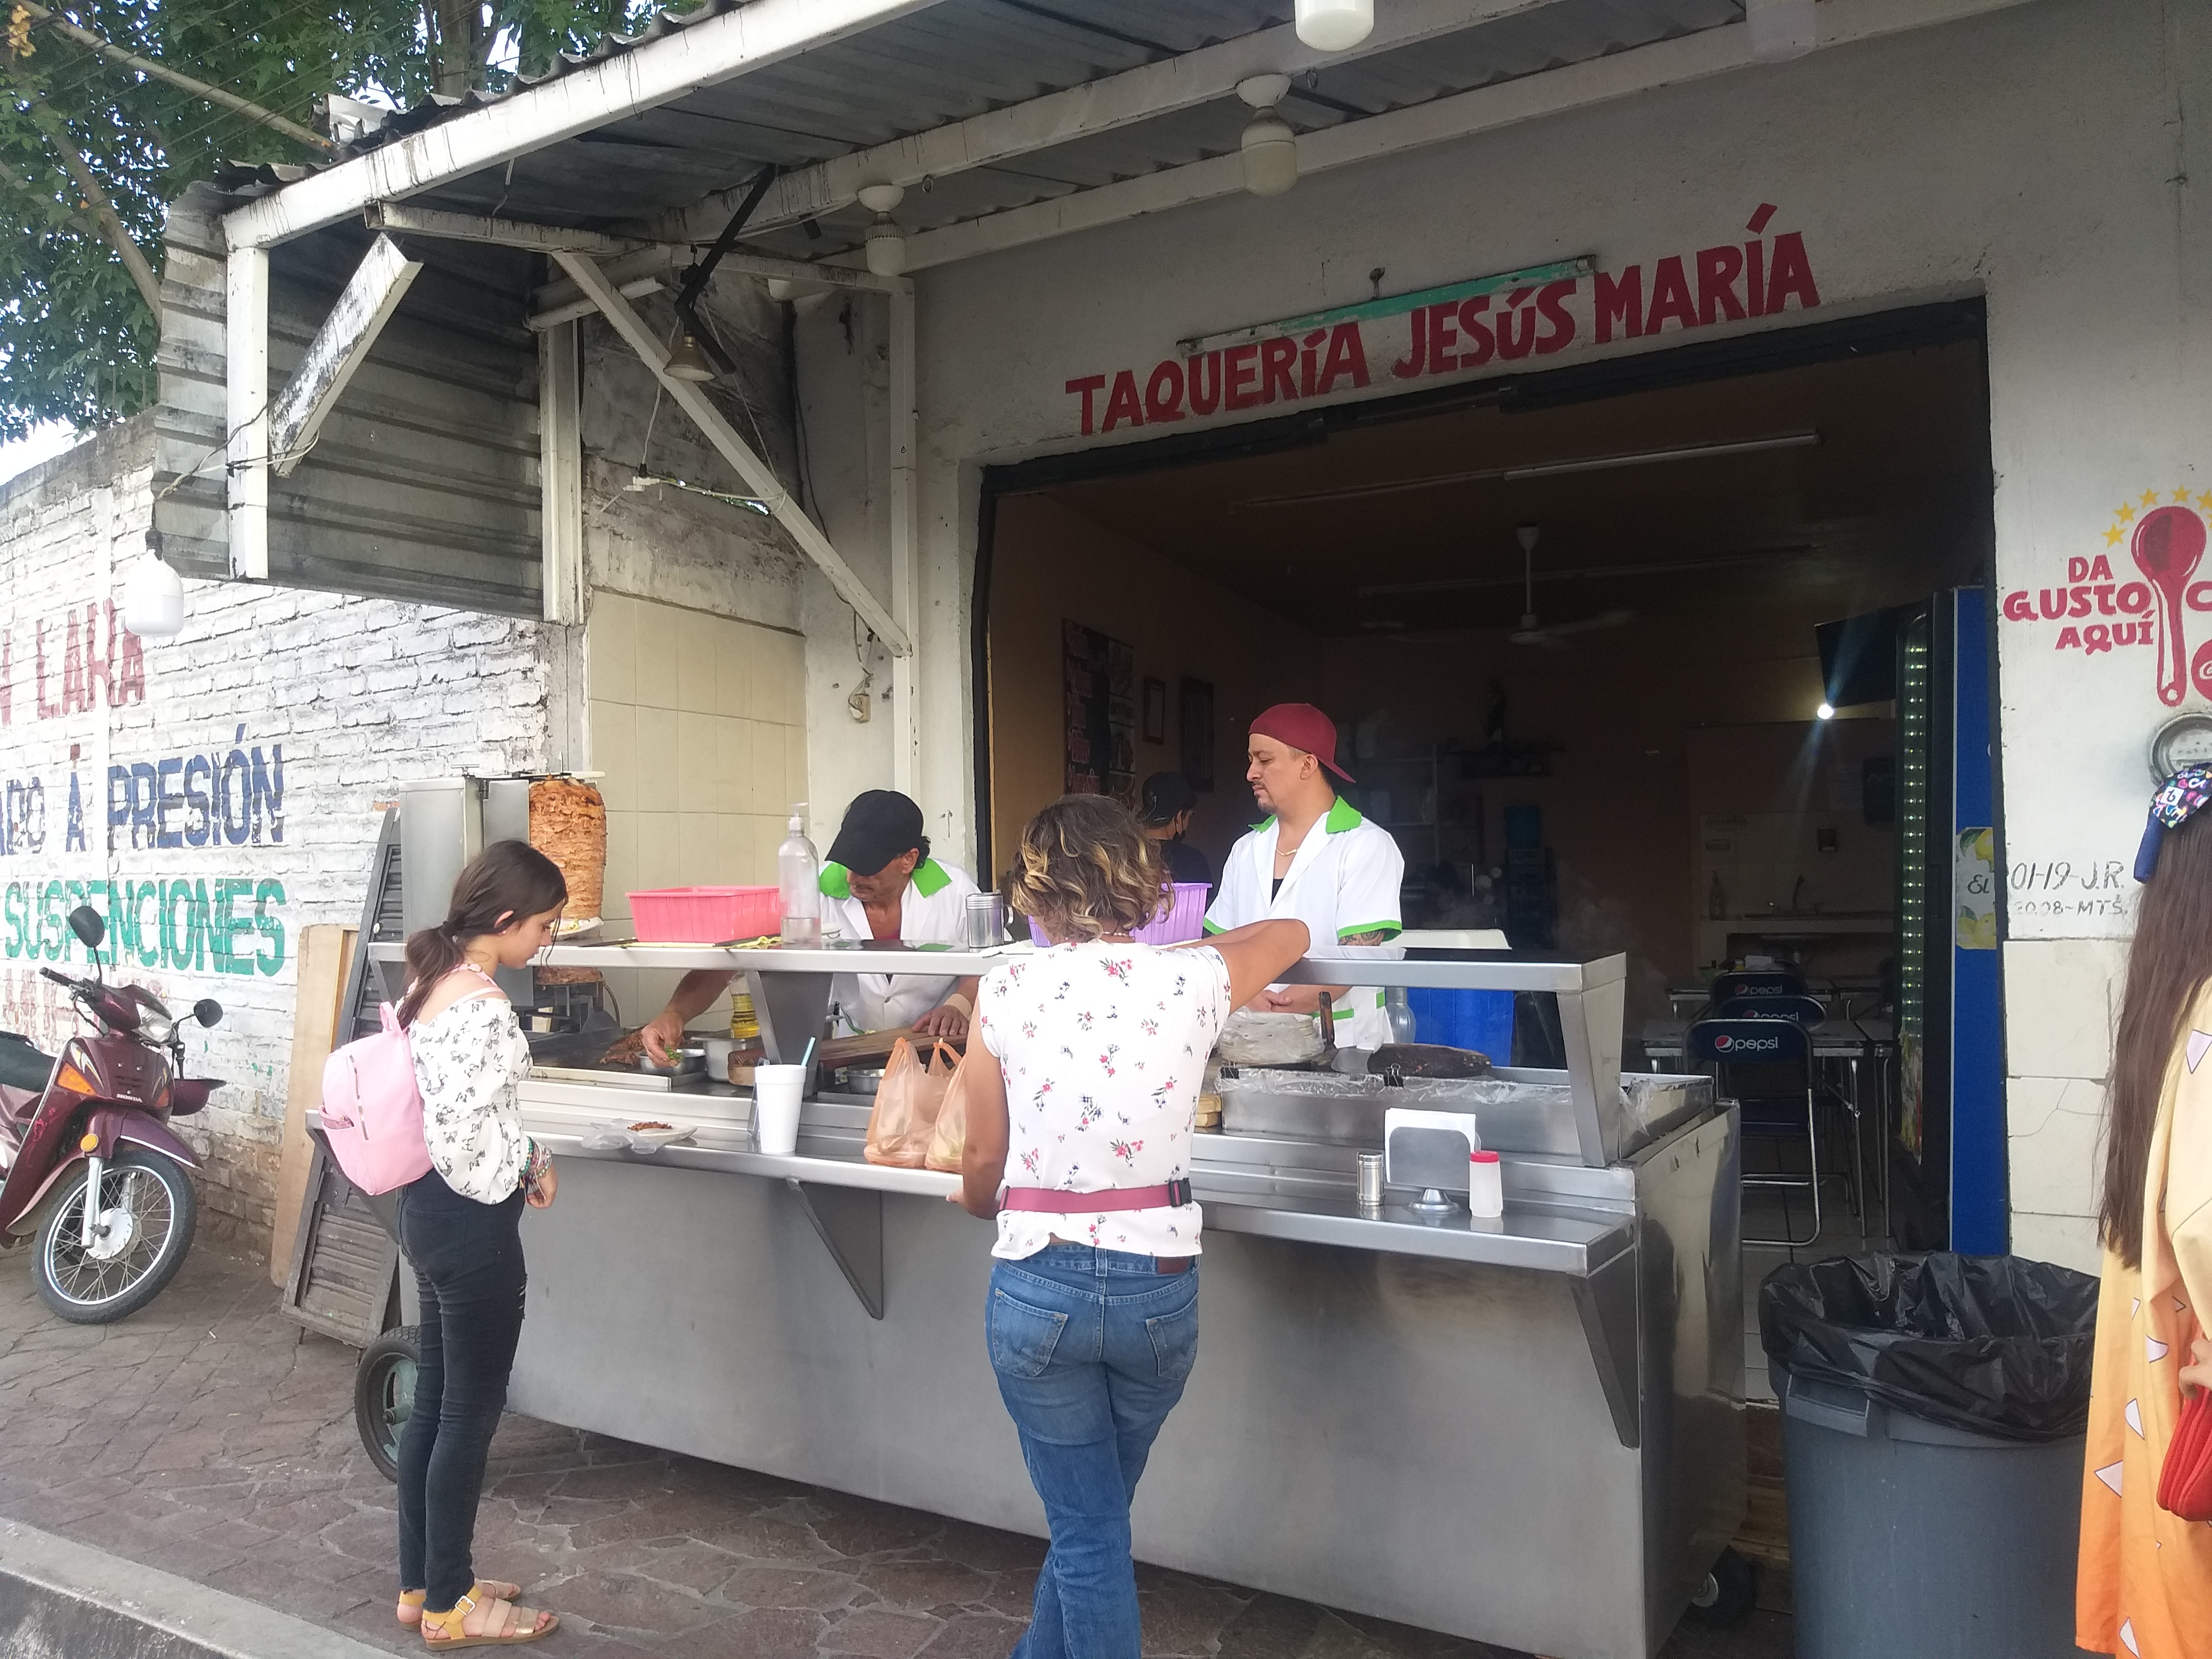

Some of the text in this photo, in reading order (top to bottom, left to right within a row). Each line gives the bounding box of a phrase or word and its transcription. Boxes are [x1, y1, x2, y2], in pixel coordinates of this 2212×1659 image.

[1066, 203, 1821, 435] TAQUERÍA JESÚS MARÍA
[2068, 554, 2114, 584] DA
[2003, 581, 2152, 621] GUSTO
[2055, 609, 2155, 656] AQUÍ
[108, 723, 284, 849] PRESIÓN
[5, 878, 287, 976] SUSPENCIONES
[1735, 1036, 1778, 1051] pepsi
[116, 1094, 143, 1103] HONDA
